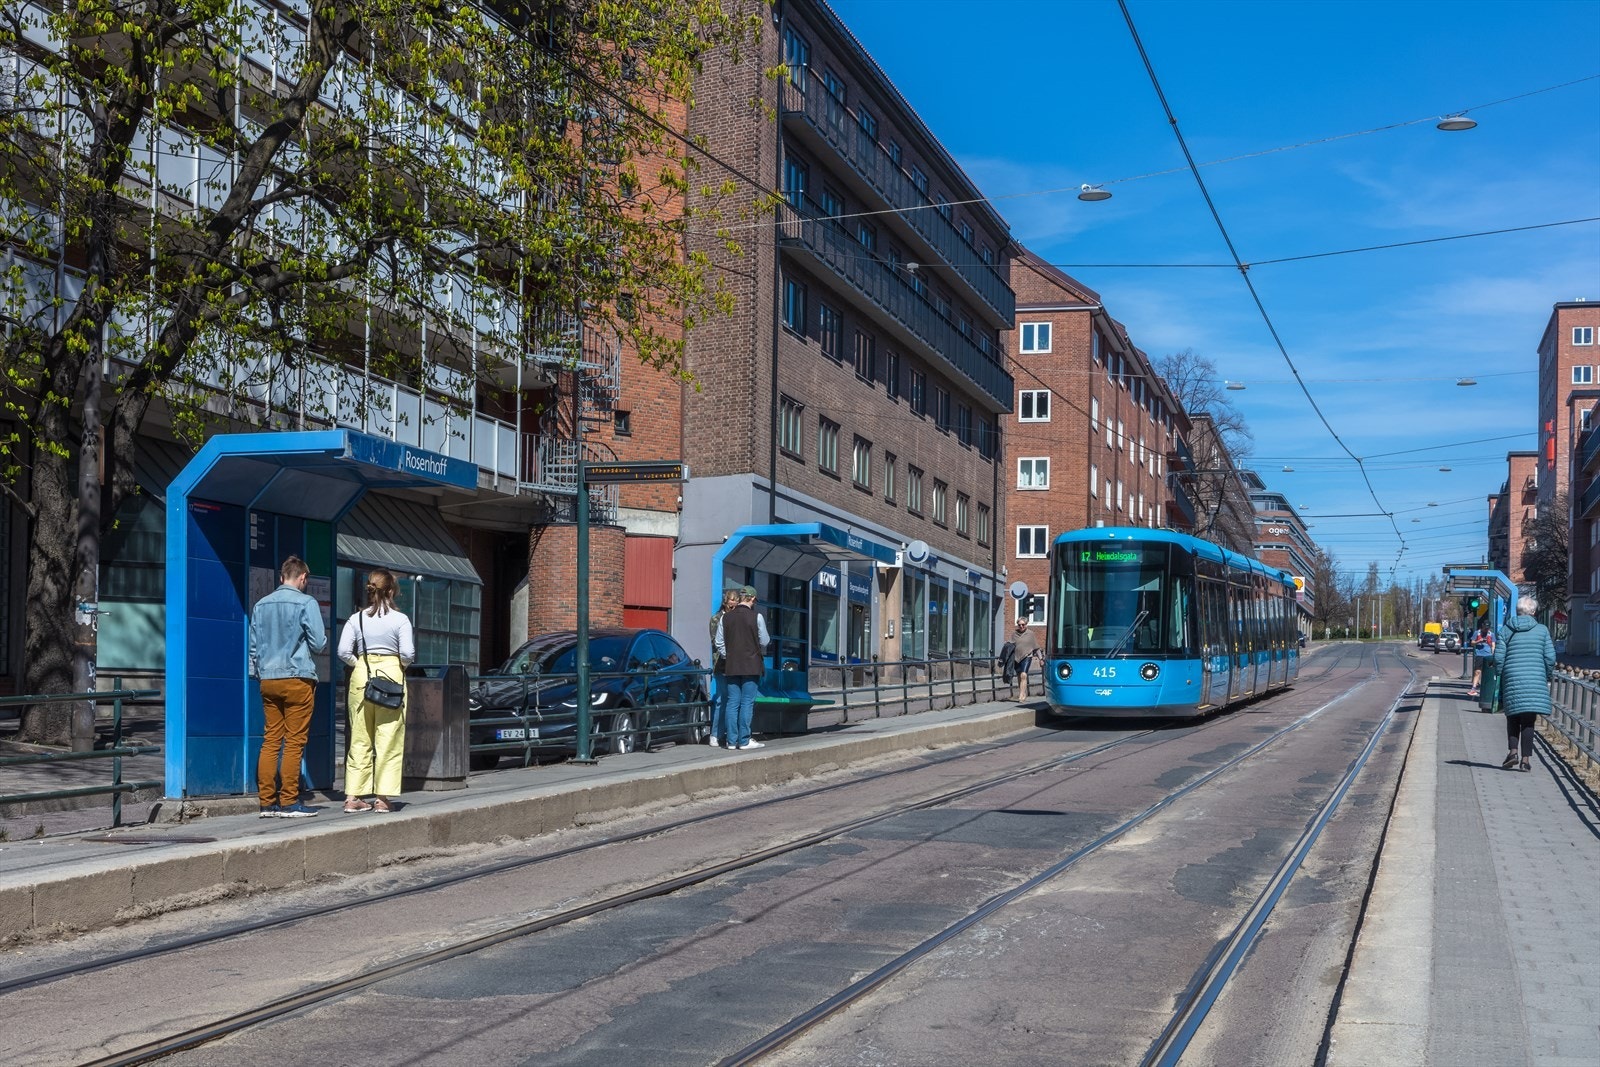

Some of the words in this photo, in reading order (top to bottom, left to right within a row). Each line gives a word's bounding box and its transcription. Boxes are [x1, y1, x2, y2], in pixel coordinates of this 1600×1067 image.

[405, 450, 447, 476] Rosenhoff
[1081, 551, 1091, 562] 17
[1096, 551, 1137, 563] Heimdalsgata
[1093, 666, 1116, 678] 415
[503, 730, 512, 738] EV
